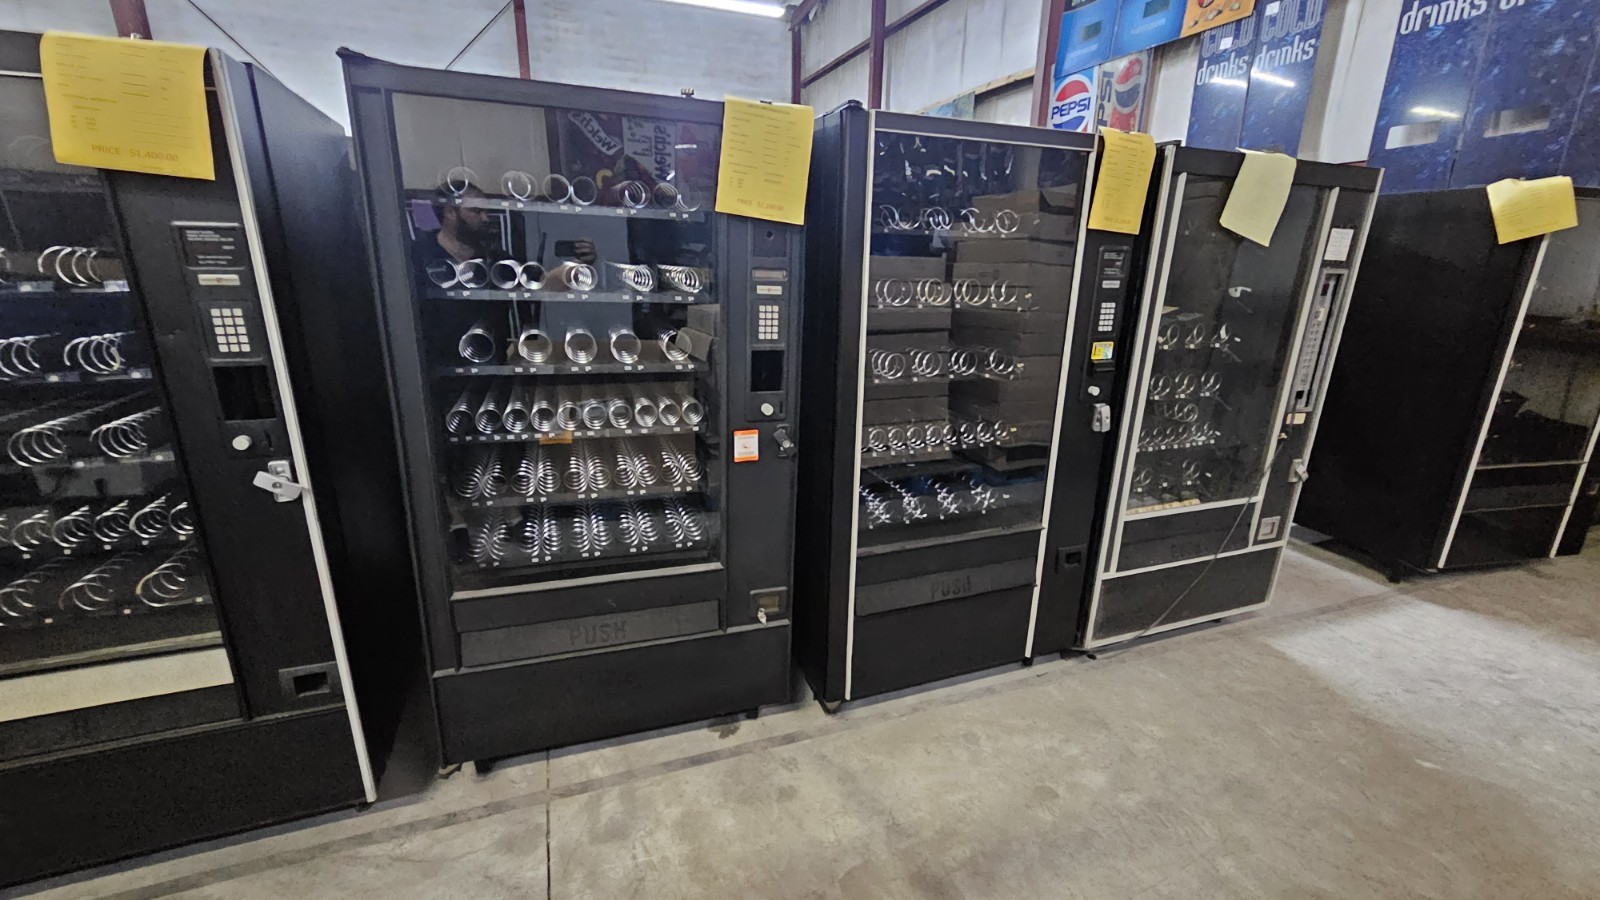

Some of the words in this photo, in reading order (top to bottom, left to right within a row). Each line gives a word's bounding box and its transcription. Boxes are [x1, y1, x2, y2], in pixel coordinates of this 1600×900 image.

[1260, 0, 1323, 42] COLD
[1400, 0, 1487, 35] drinks
[1196, 52, 1249, 85] drinks
[1253, 36, 1316, 72] drinks
[1051, 97, 1091, 120] PEPSI
[1097, 70, 1115, 127] PSI
[91, 143, 120, 156] PRICE
[930, 575, 973, 600] PUSH
[569, 620, 627, 646] PUSH
